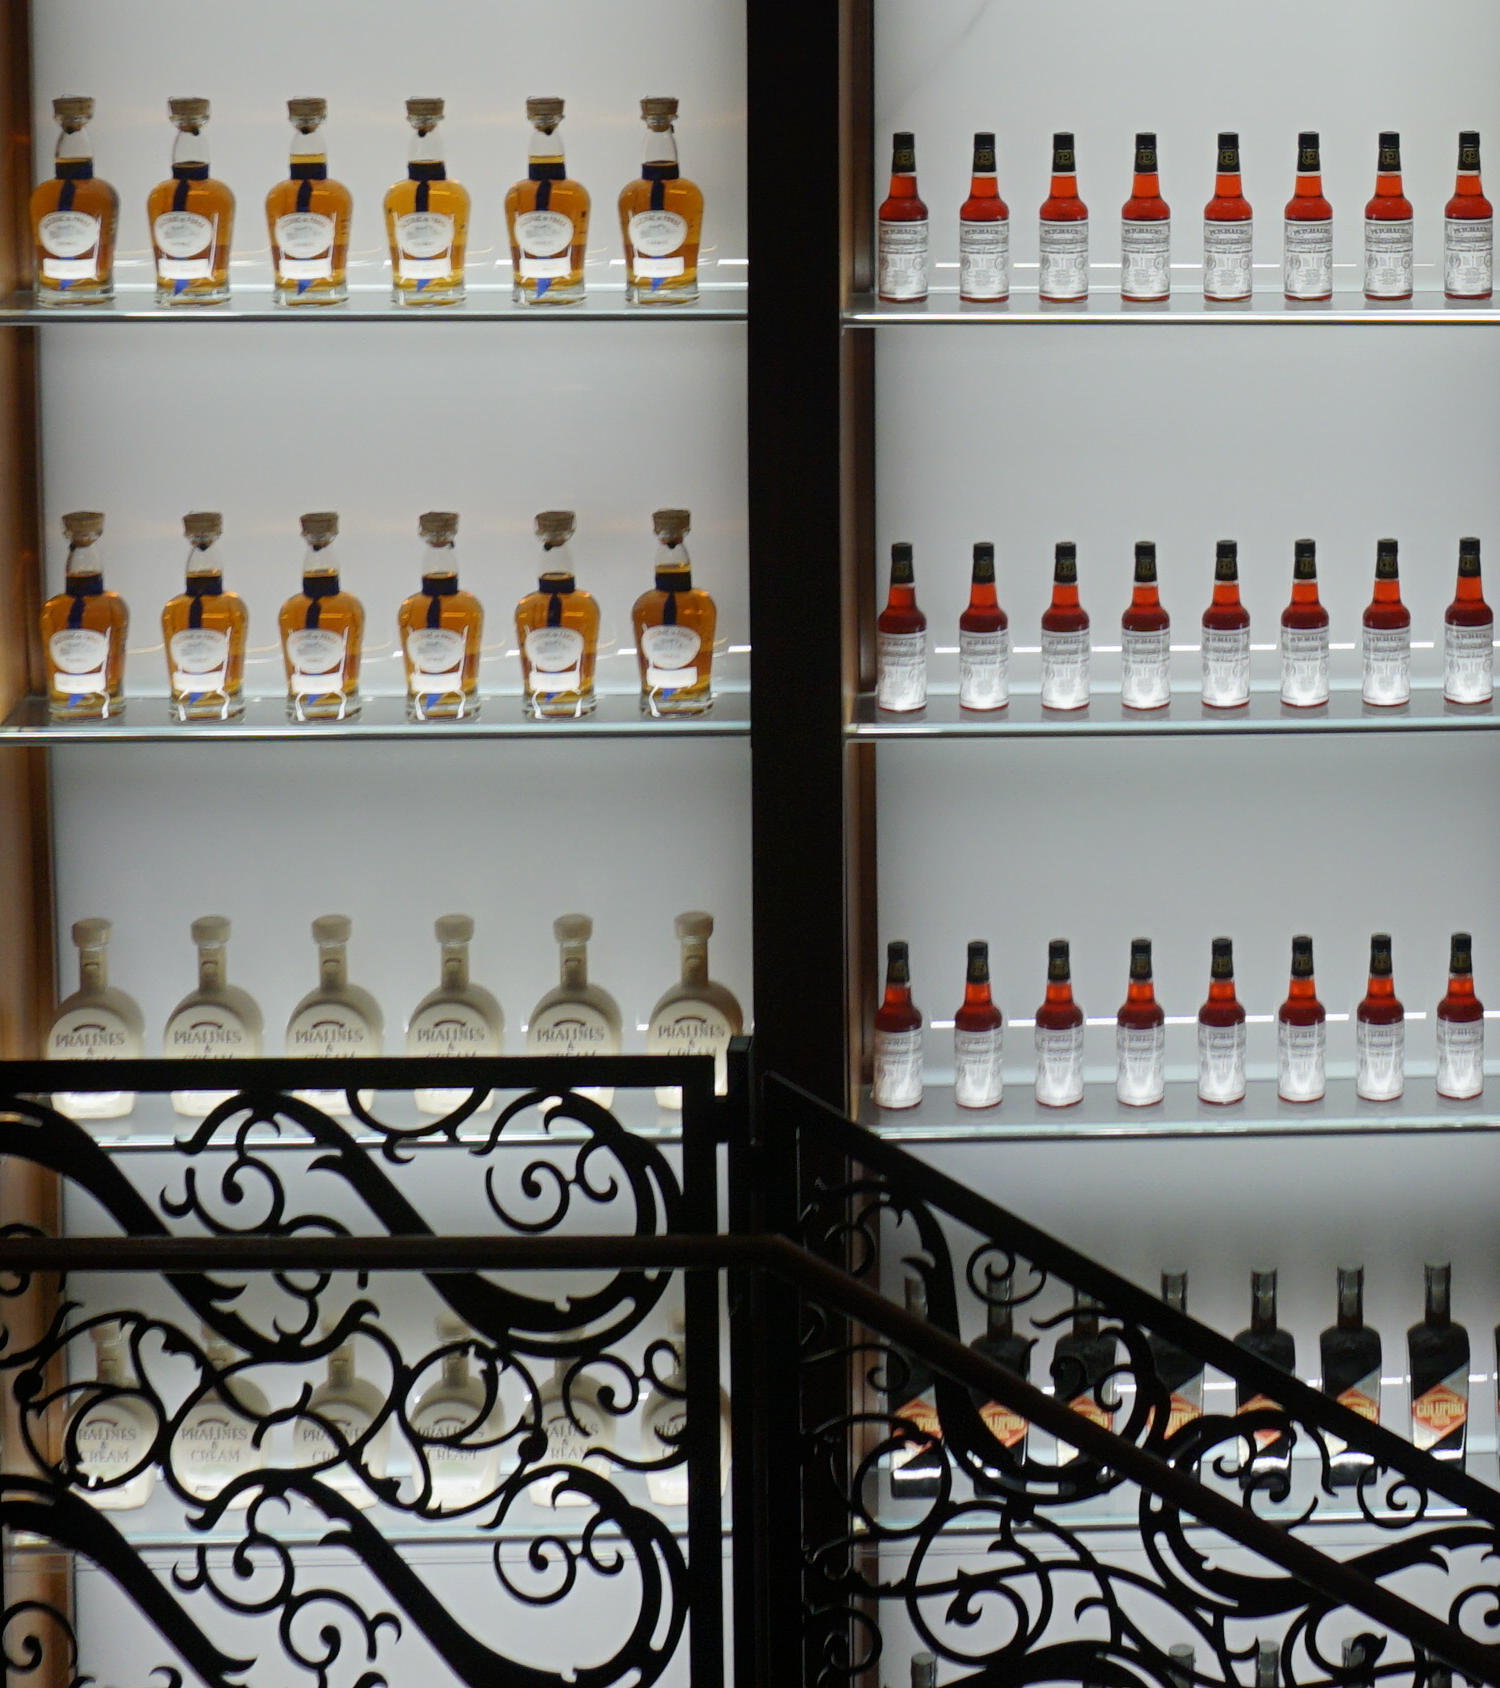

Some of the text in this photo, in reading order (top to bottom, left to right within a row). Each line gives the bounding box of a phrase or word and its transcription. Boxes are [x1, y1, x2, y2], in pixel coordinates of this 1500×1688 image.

[174, 1029, 242, 1044] PRALINES
[295, 1029, 364, 1044] PRALINES
[417, 1027, 484, 1042] PRALINES
[537, 1028, 605, 1042] PRALINES
[658, 1024, 725, 1038] PRALINES
[56, 1032, 125, 1047] PRALINES
[78, 1427, 136, 1440] RALINES
[181, 1426, 248, 1440] PRALINES
[191, 1450, 240, 1462] CREAM
